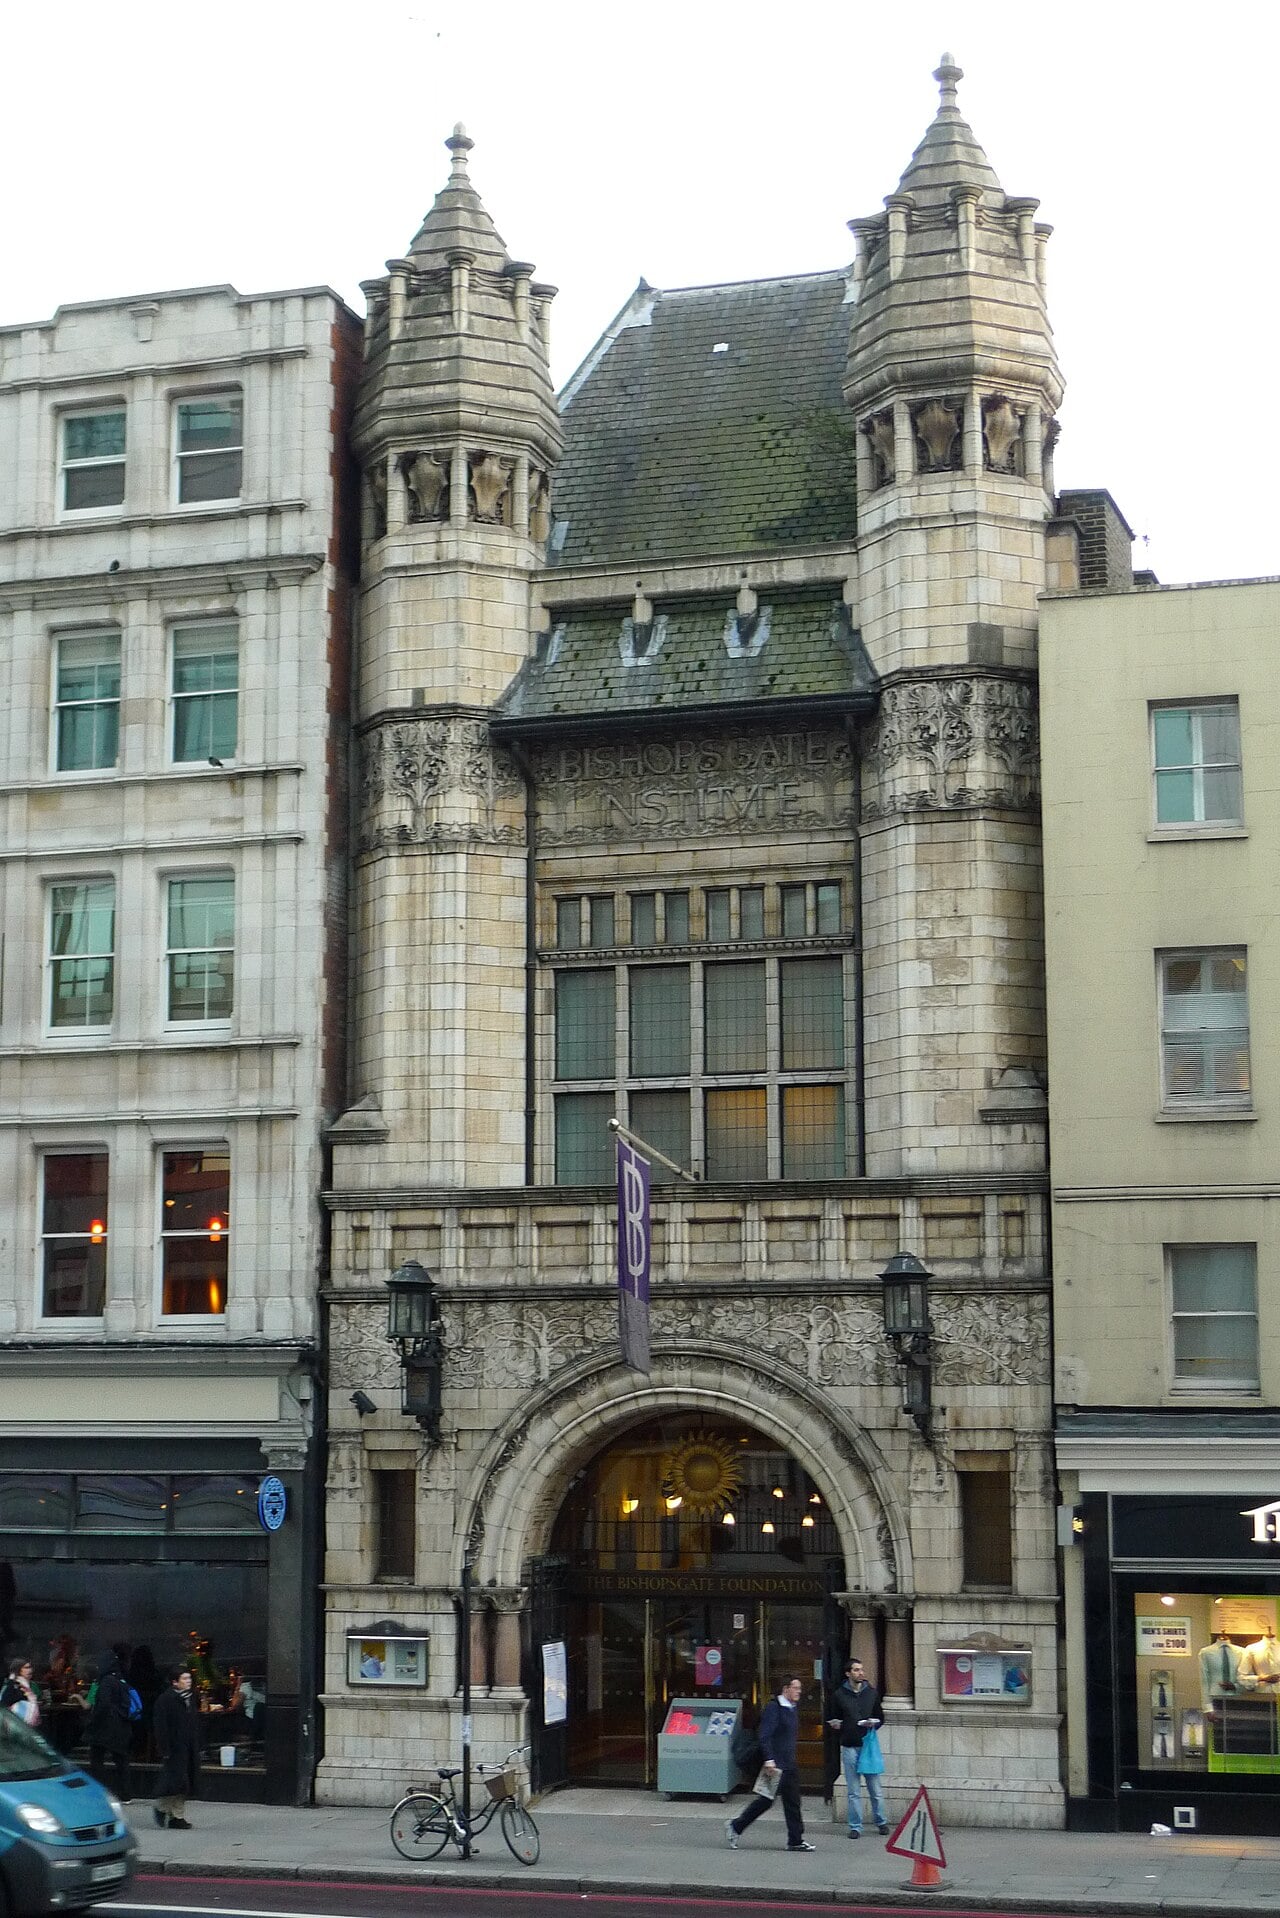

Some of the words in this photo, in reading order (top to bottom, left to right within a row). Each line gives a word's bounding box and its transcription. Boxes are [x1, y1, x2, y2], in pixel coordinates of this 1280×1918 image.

[558, 730, 828, 782] BISHOPSGATE
[585, 1576, 613, 1590] THE
[617, 1577, 713, 1592] BISHOPSGATE
[719, 1578, 825, 1593] FOUNDATION
